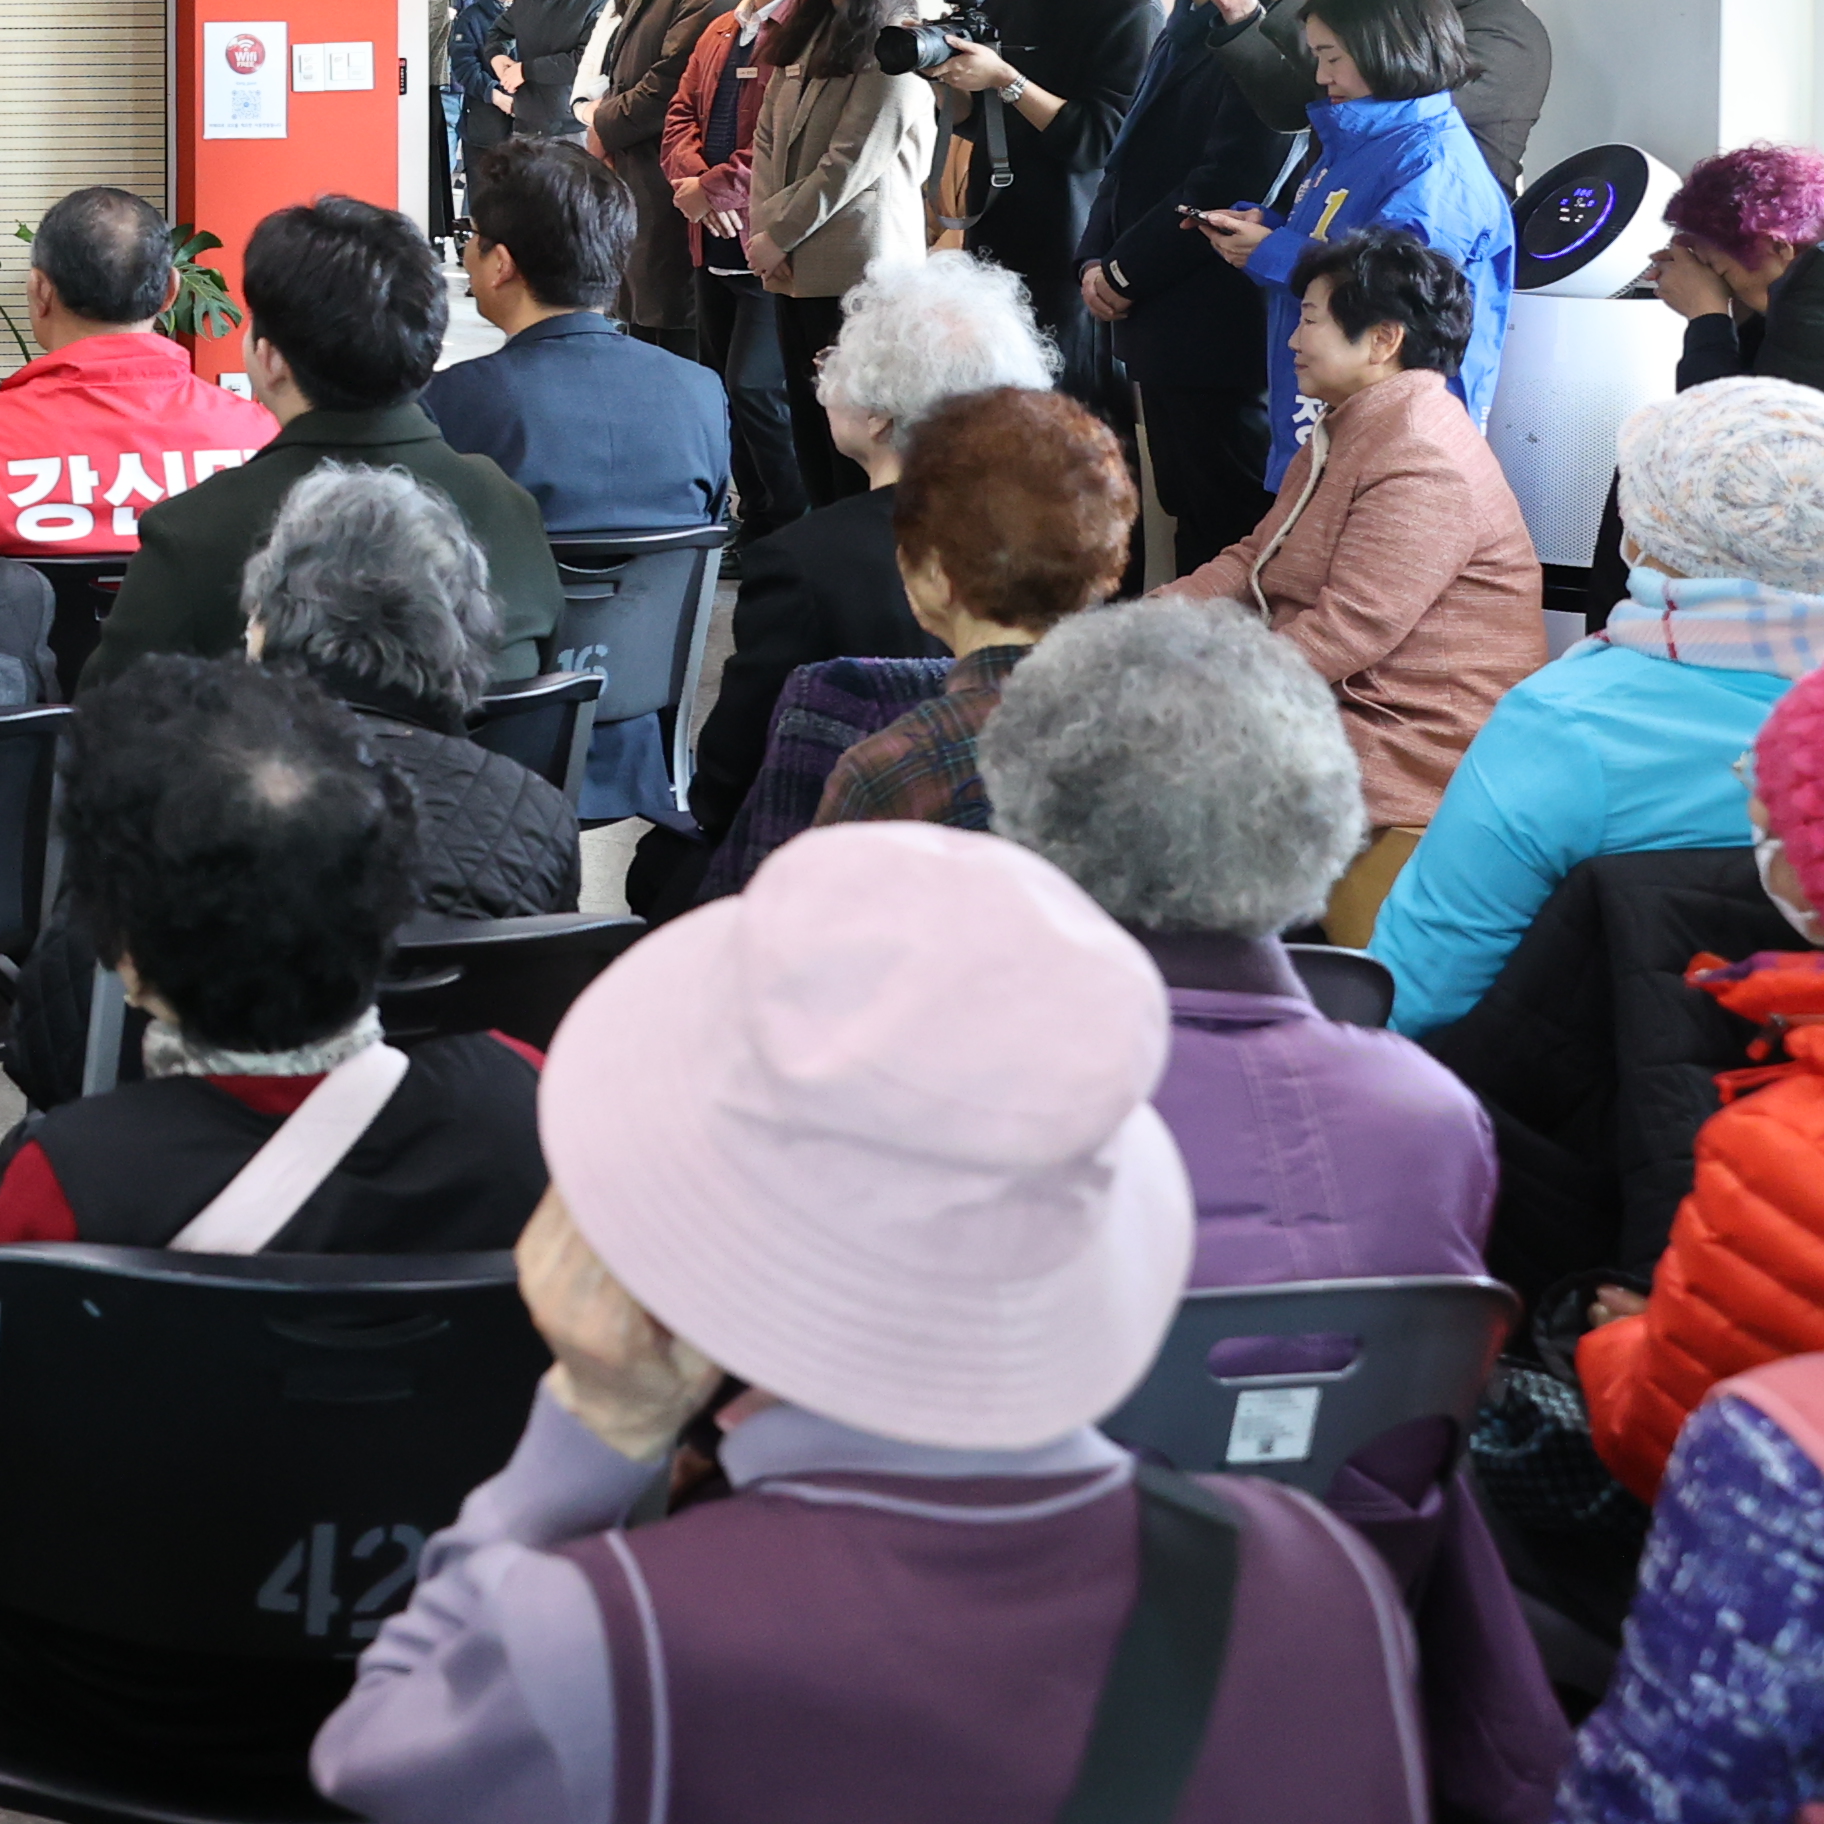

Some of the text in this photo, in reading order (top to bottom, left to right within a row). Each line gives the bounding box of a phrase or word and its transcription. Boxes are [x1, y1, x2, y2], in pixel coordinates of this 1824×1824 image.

[234, 51, 258, 62] Wifi
[1309, 187, 1349, 244] 1
[256, 1522, 428, 1640] 42
